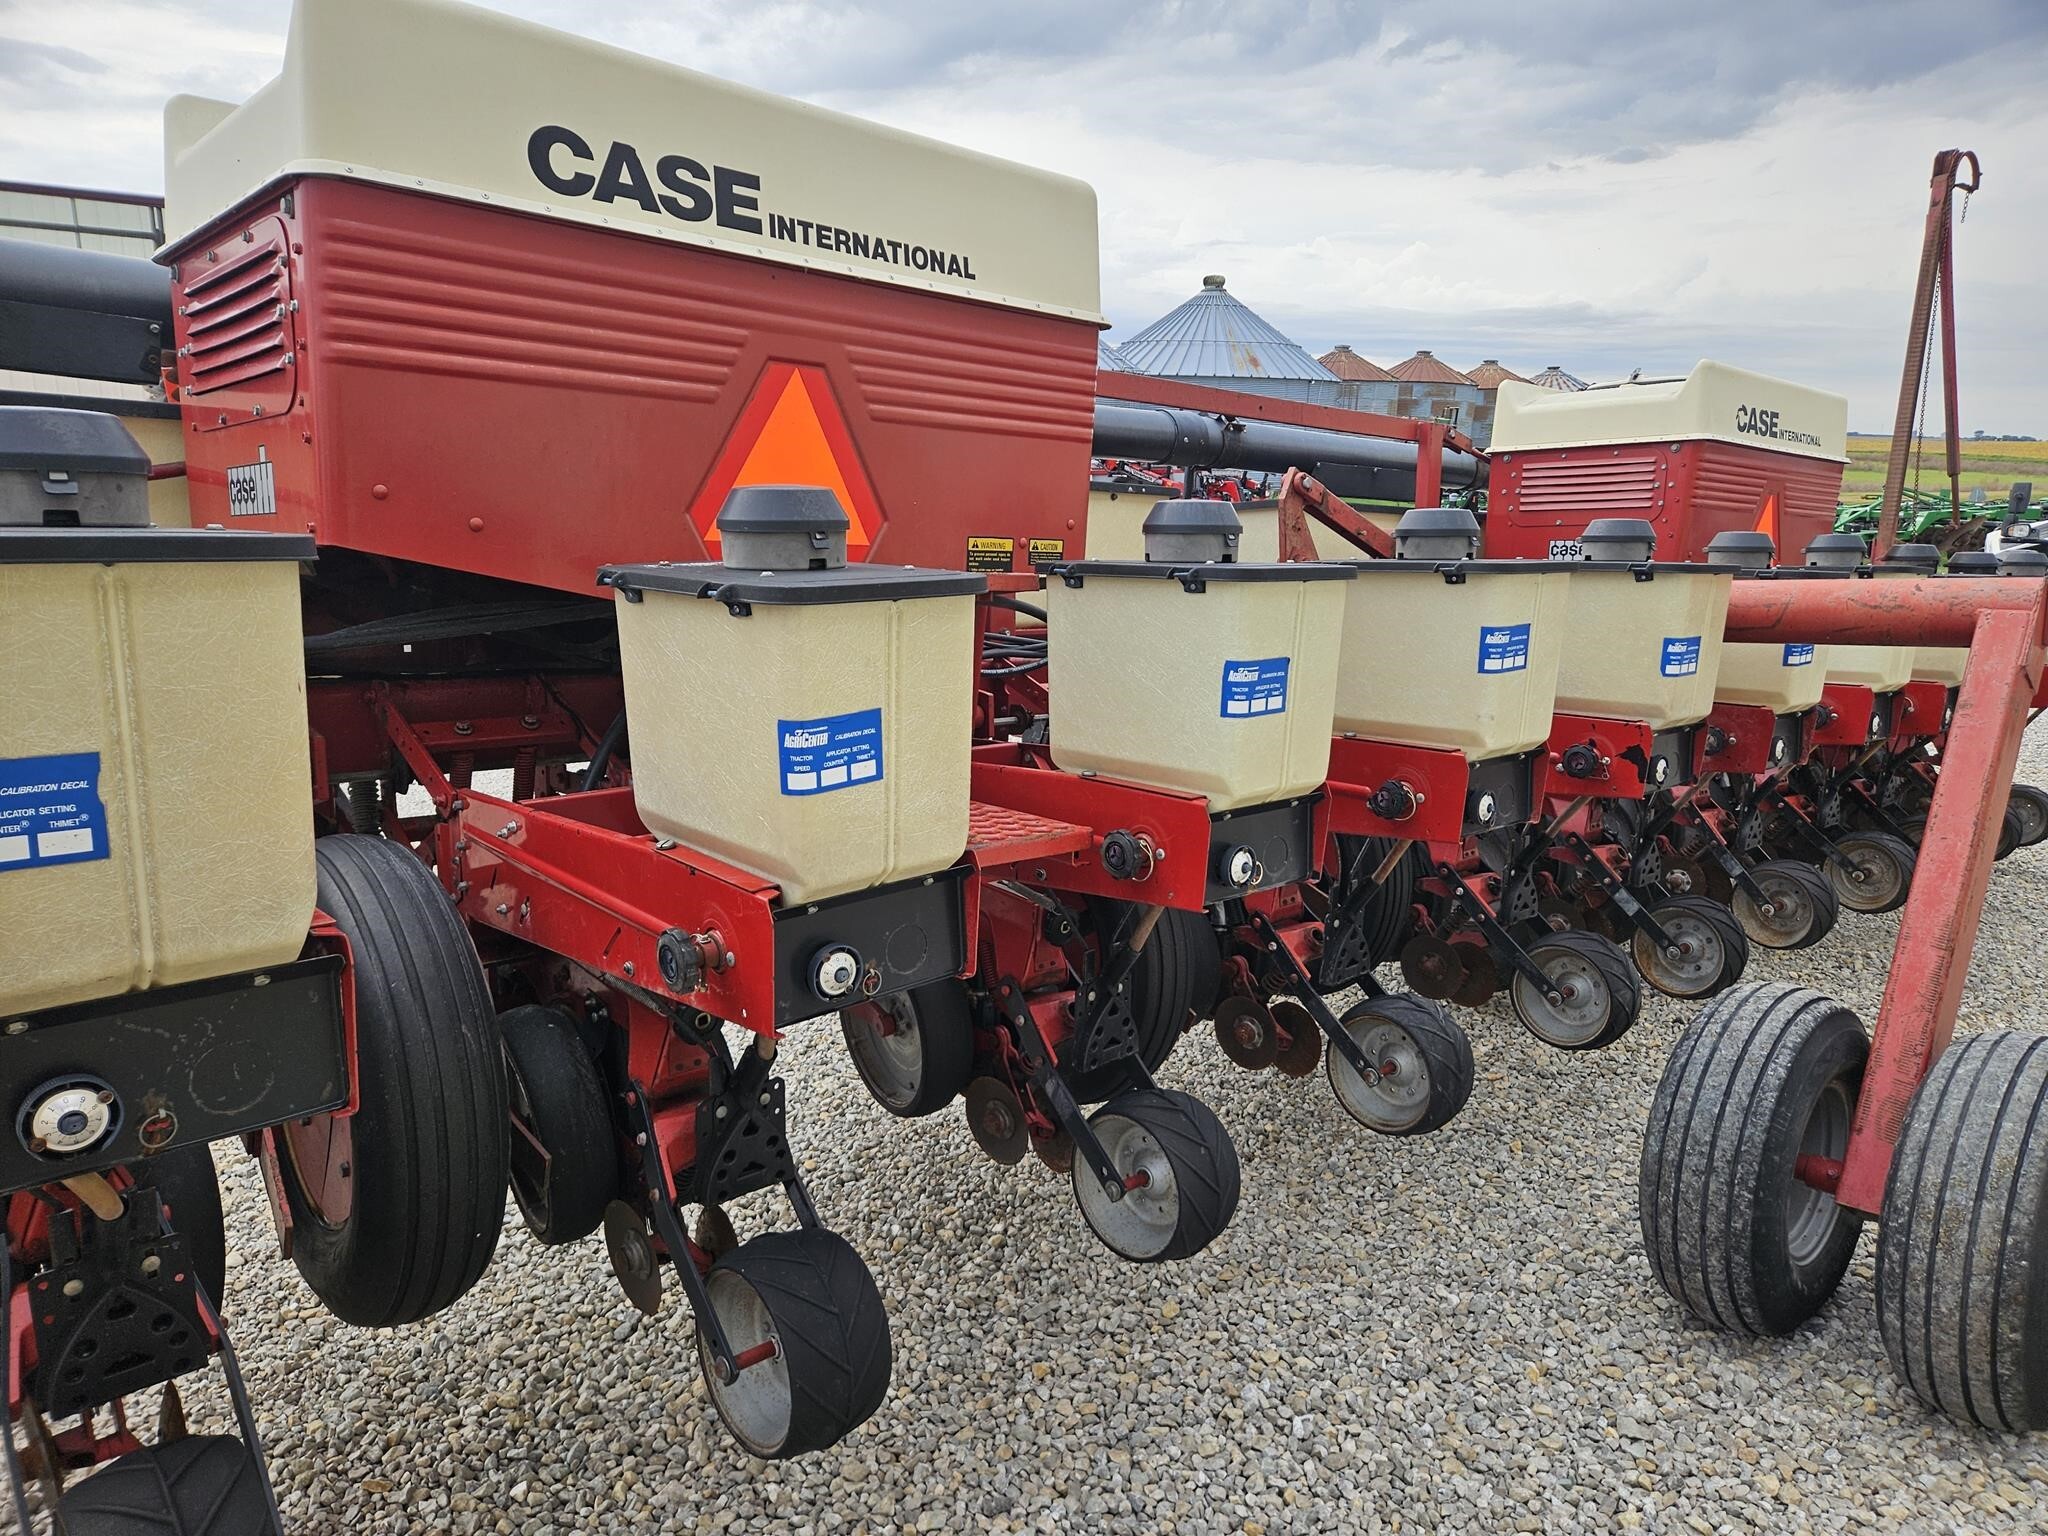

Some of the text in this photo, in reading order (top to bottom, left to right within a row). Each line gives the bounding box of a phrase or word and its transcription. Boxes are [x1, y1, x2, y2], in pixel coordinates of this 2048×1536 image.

[527, 125, 976, 280] CASE INTERNATIONAL
[1736, 404, 1821, 447] CASE INTERNATIONAL
[981, 541, 1006, 550] WARNING
[1040, 543, 1058, 551] CAUTION
[826, 744, 870, 757] APPLICATOR SETTING
[0, 780, 89, 796] CALIBRATION DECAL
[39, 804, 76, 815] SETTING
